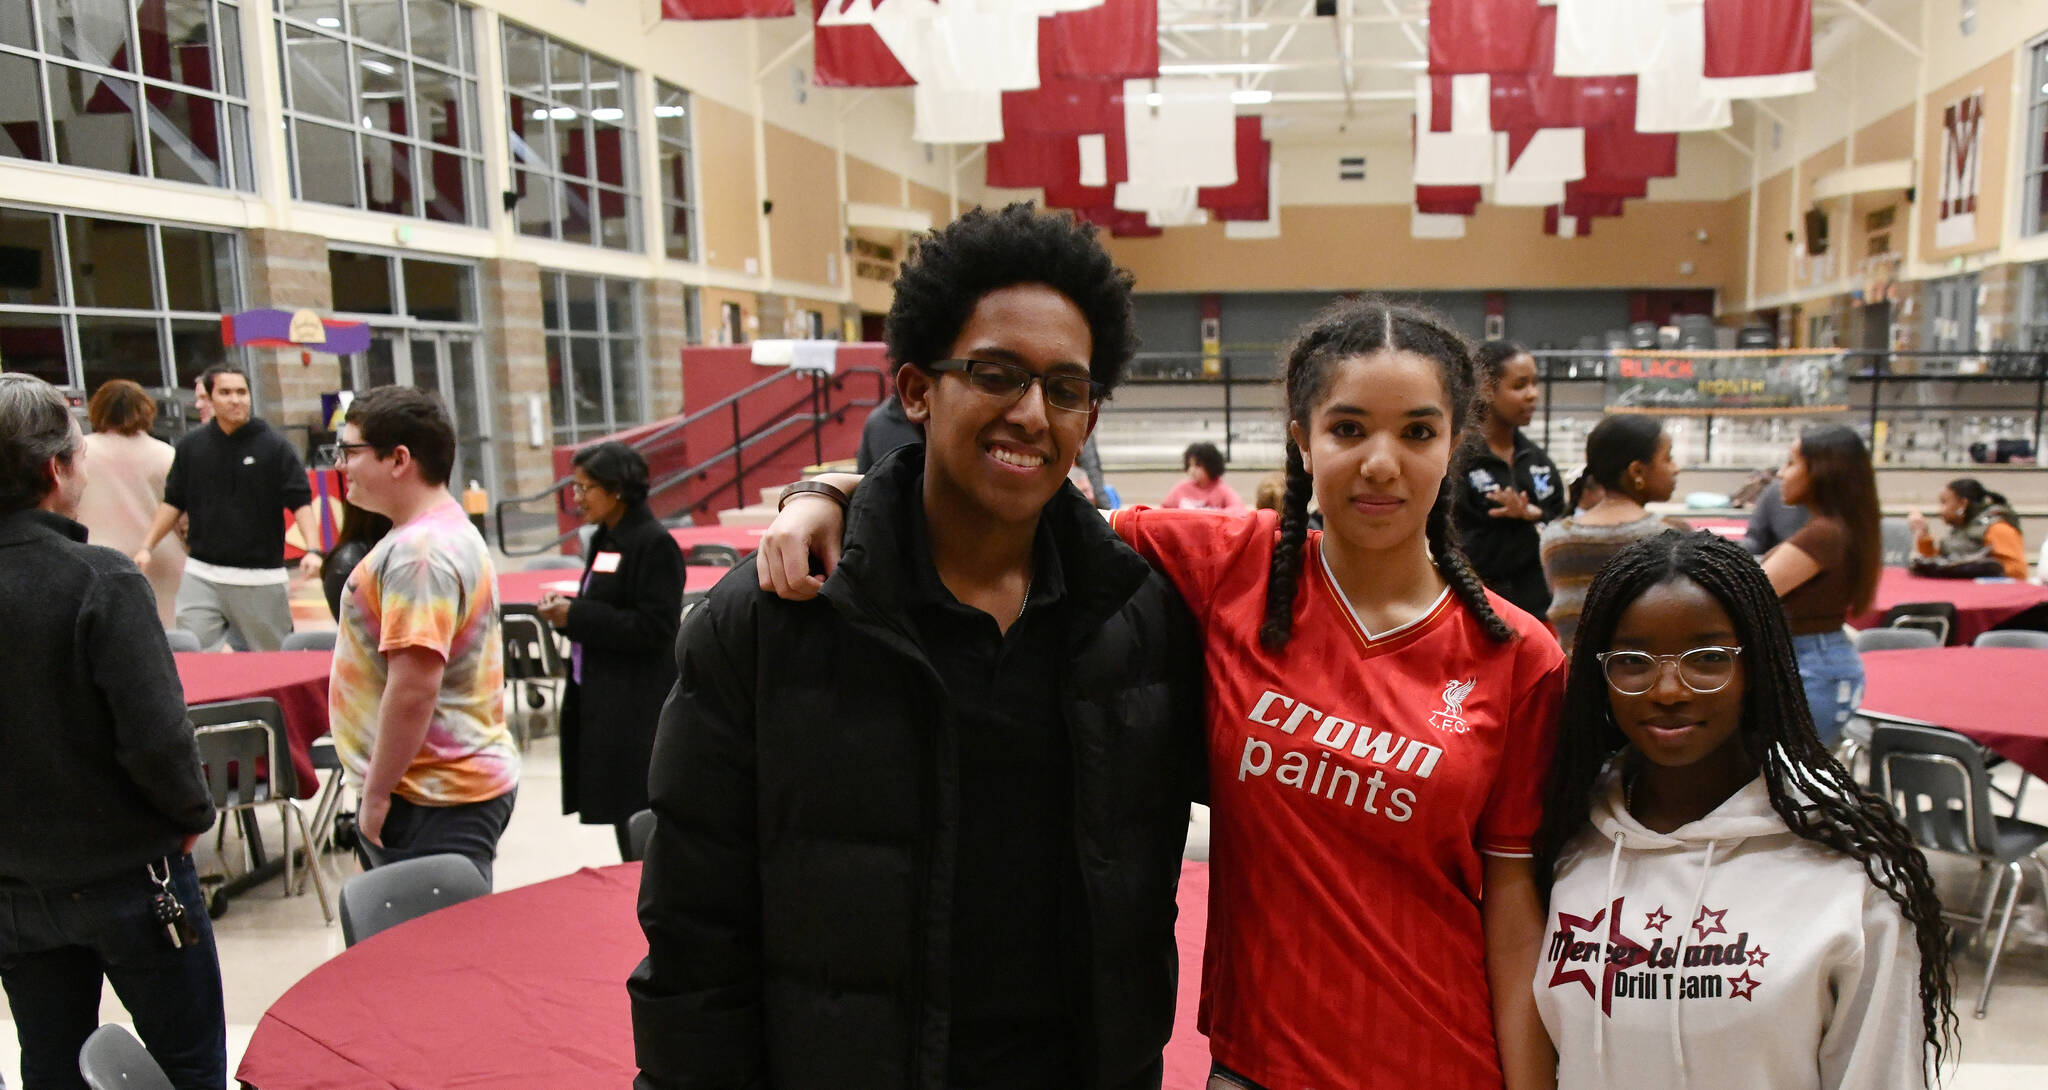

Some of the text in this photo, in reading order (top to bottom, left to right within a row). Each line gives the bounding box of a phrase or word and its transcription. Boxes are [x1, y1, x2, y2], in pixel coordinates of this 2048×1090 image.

[1620, 358, 1694, 378] BLACK
[1248, 690, 1443, 779] crown
[1428, 714, 1470, 734] L.F.C.
[1238, 735, 1417, 823] paints
[1615, 971, 1657, 1000] Drill
